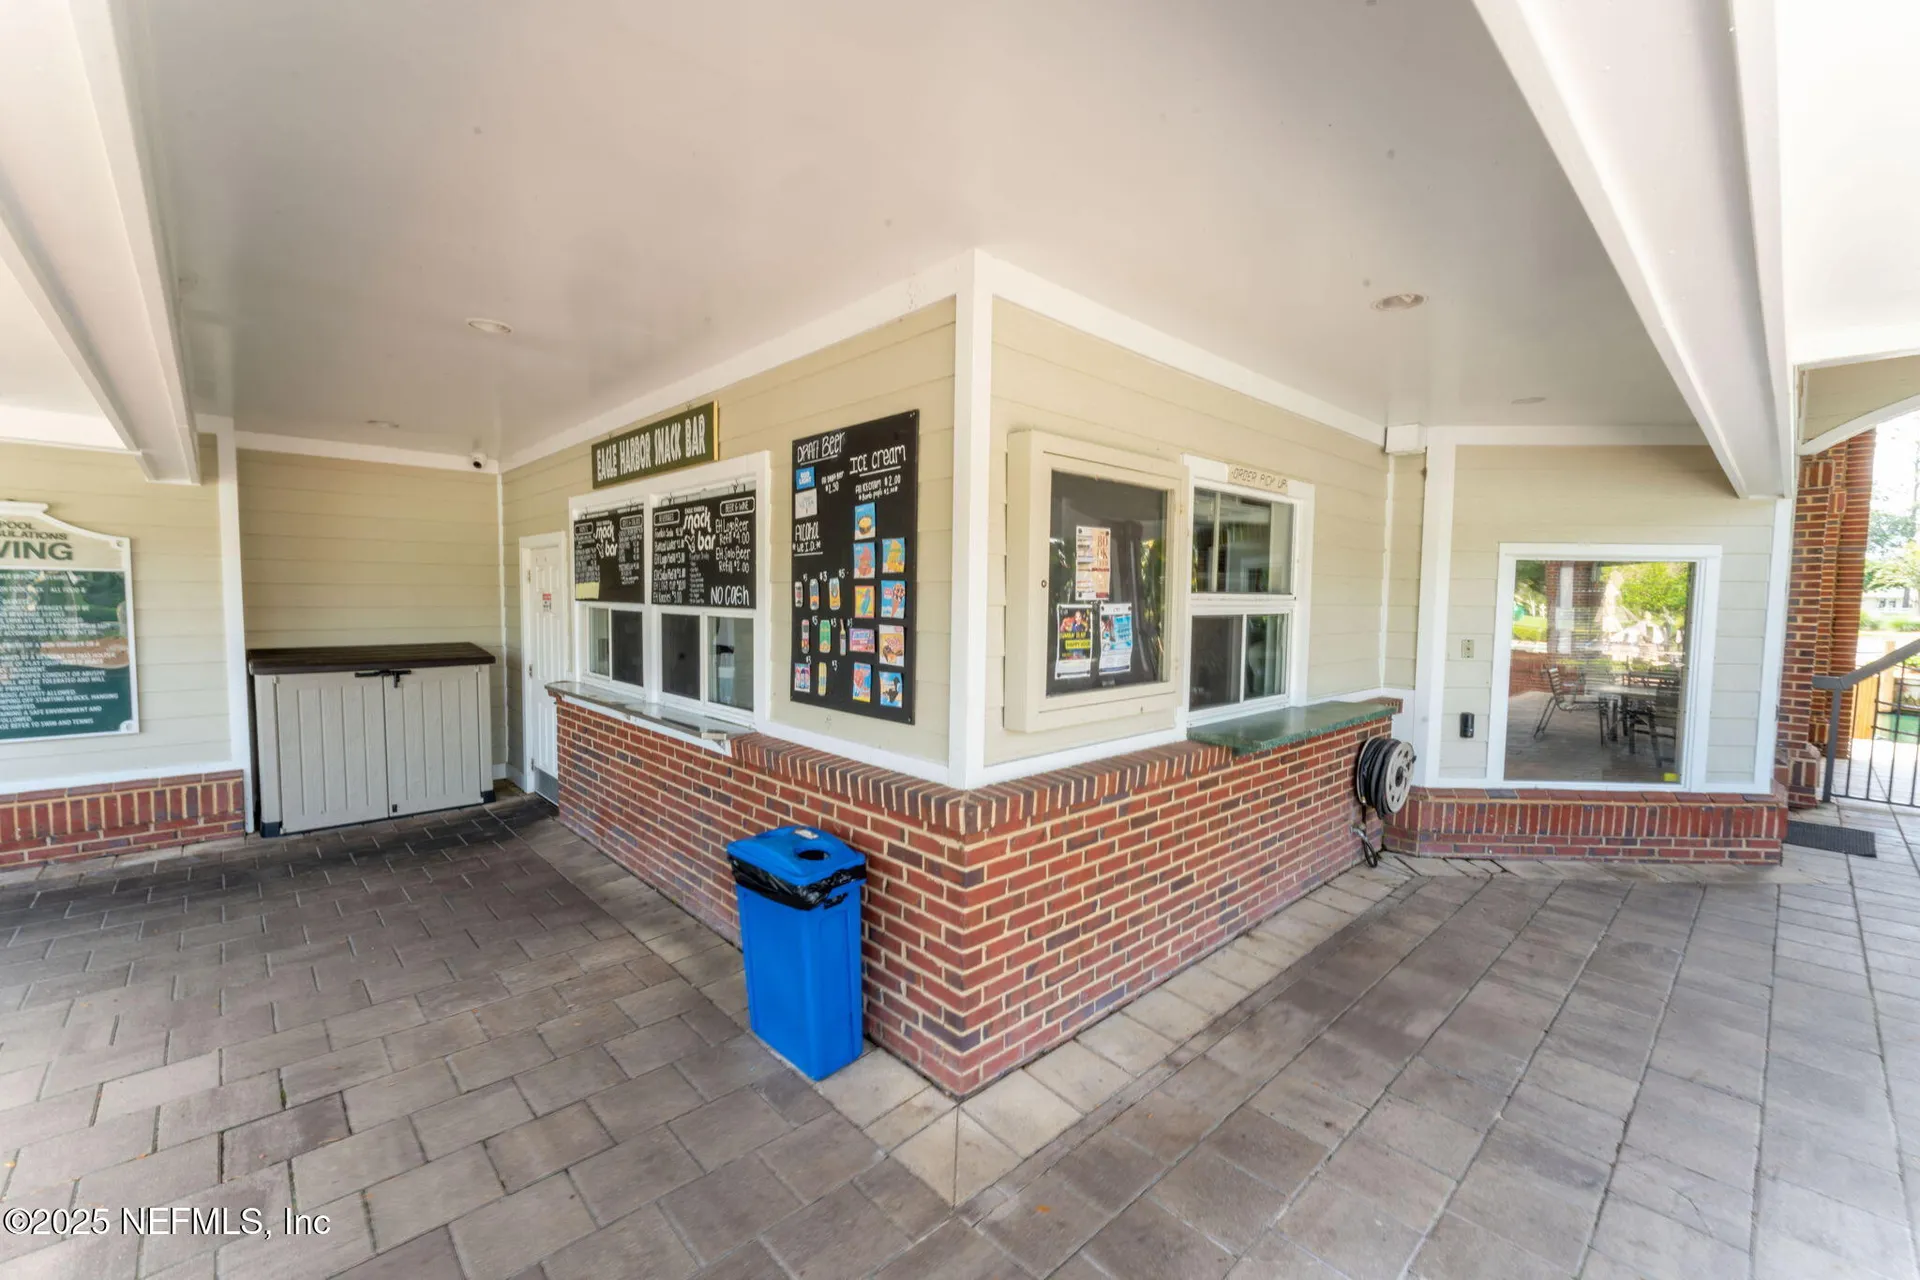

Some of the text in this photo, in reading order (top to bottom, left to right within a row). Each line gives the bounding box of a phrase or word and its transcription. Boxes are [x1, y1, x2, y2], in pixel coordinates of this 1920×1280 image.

[596, 413, 706, 482] EAGLE HARBOR SNACK BAR
[821, 432, 846, 458] Beer
[849, 453, 868, 475] ICE
[734, 517, 749, 532] Beer
[0, 530, 68, 541] ULATIONS
[697, 530, 716, 551] bar
[604, 540, 618, 557] bar
[735, 545, 751, 560] Beer
[42, 677, 76, 685] TOLERATED
[45, 706, 88, 715] ENVIRONMENT
[89, 705, 103, 713] AND
[11, 721, 30, 729] REFER
[41, 719, 57, 727] SWIM
[58, 718, 71, 726] AND
[73, 717, 94, 725] TENNIS
